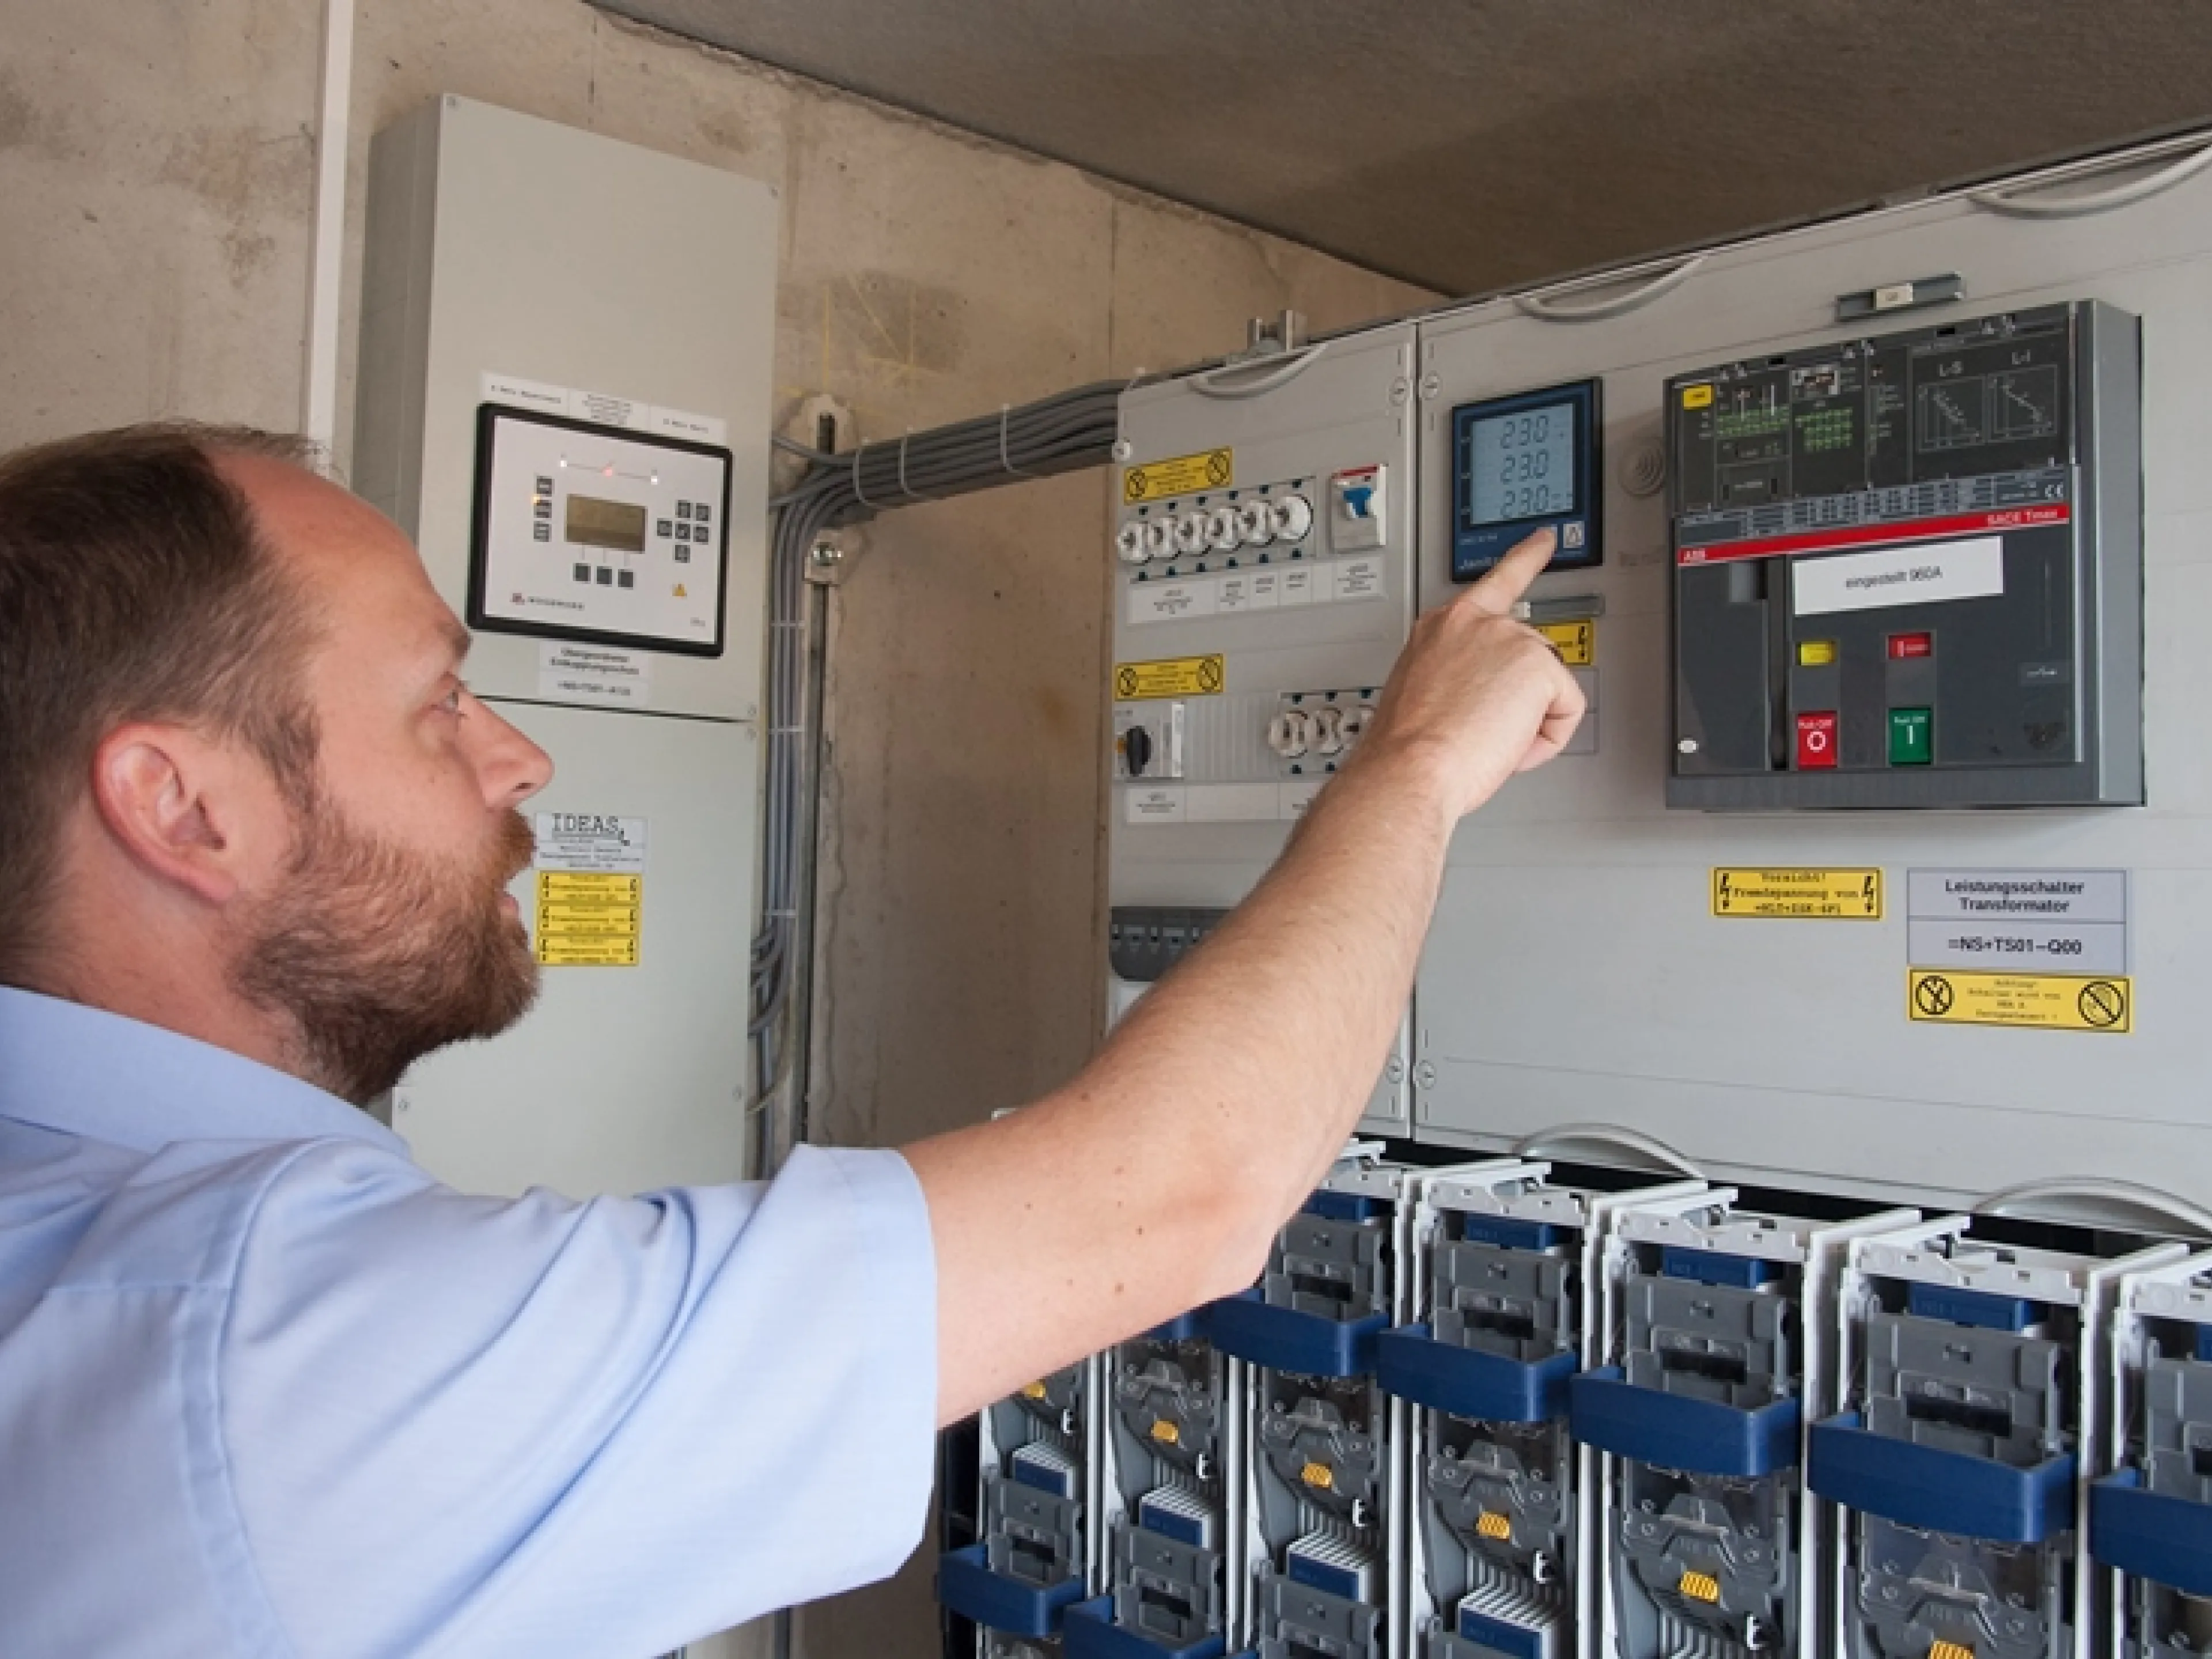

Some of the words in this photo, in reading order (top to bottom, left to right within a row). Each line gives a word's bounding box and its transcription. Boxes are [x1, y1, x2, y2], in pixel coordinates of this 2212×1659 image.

[1845, 569, 1907, 590] eingestellt
[1910, 566, 1944, 582] 960A
[551, 813, 619, 834] IDEAS
[1945, 878, 2085, 895] Leistungsschalter
[1960, 896, 2070, 913] Transformator
